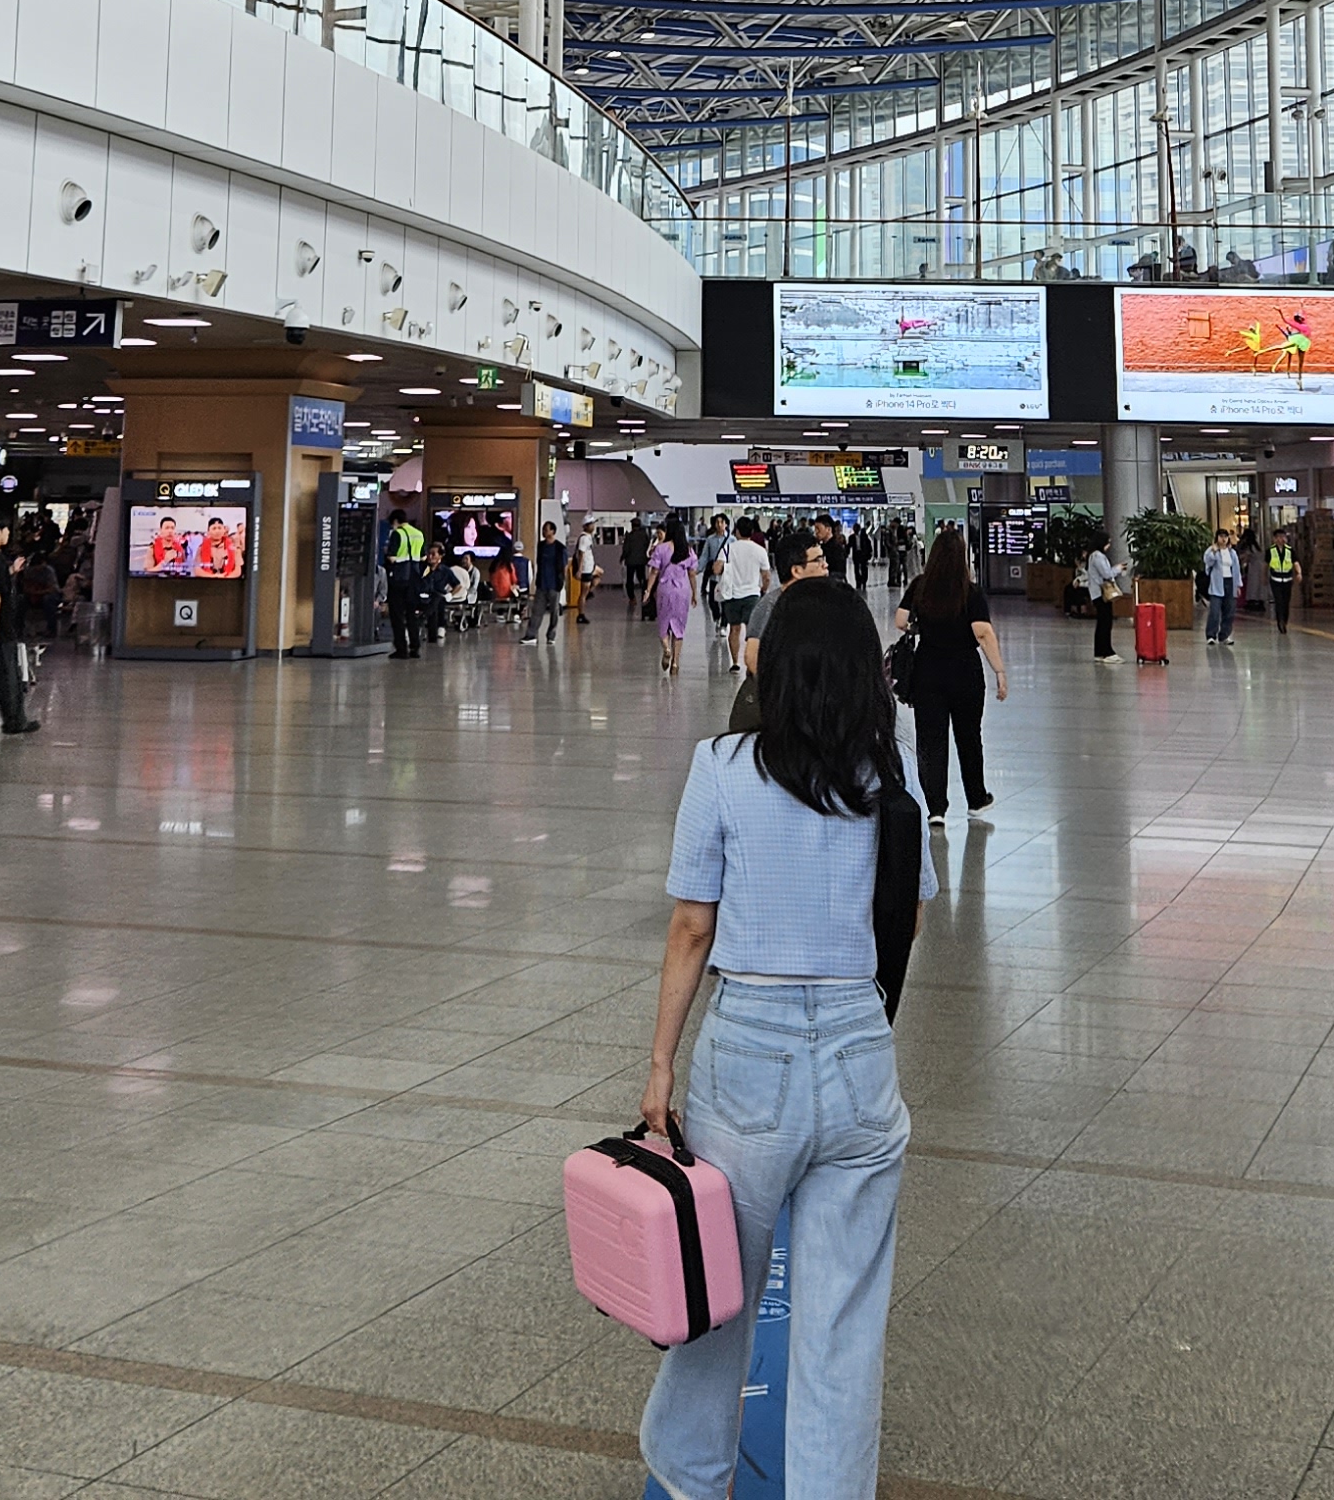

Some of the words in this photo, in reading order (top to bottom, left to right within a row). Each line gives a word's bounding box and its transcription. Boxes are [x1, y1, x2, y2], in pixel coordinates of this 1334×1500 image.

[875, 399, 905, 409] iPhone
[906, 399, 915, 409] 14
[1220, 405, 1250, 414] iPhone
[1251, 405, 1261, 414] 14
[320, 516, 332, 571] SAMSUNG
[179, 605, 193, 621] Q
